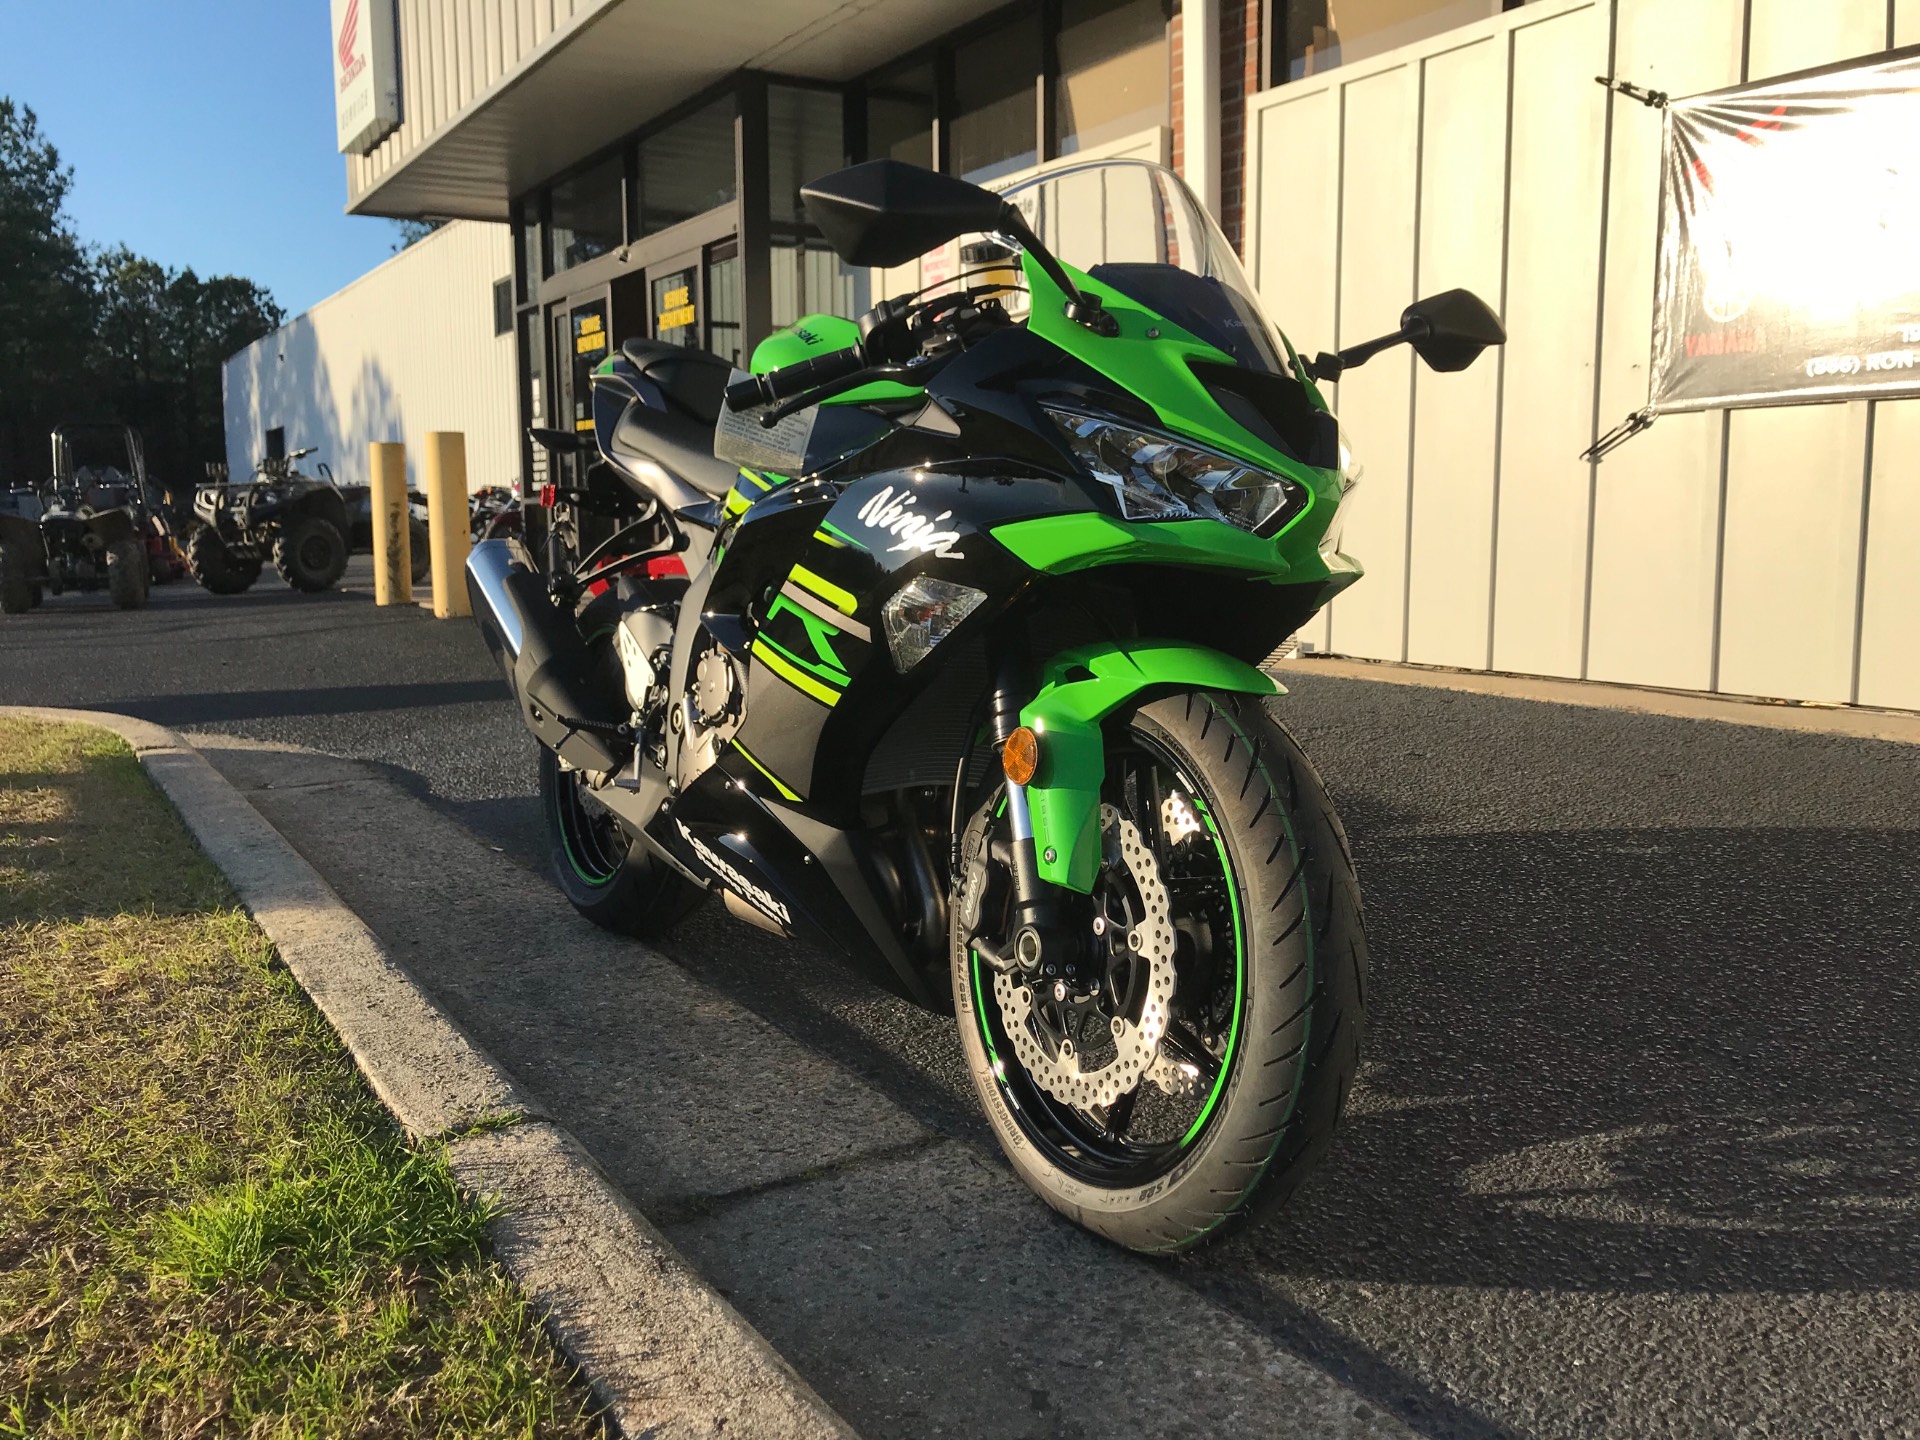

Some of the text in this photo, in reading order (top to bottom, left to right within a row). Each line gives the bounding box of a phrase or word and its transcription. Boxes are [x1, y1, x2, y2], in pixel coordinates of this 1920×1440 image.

[857, 486, 965, 559] Ninja
[675, 817, 792, 925] Kawasaki
[982, 1075, 1025, 1146] BRIDGESTONE
